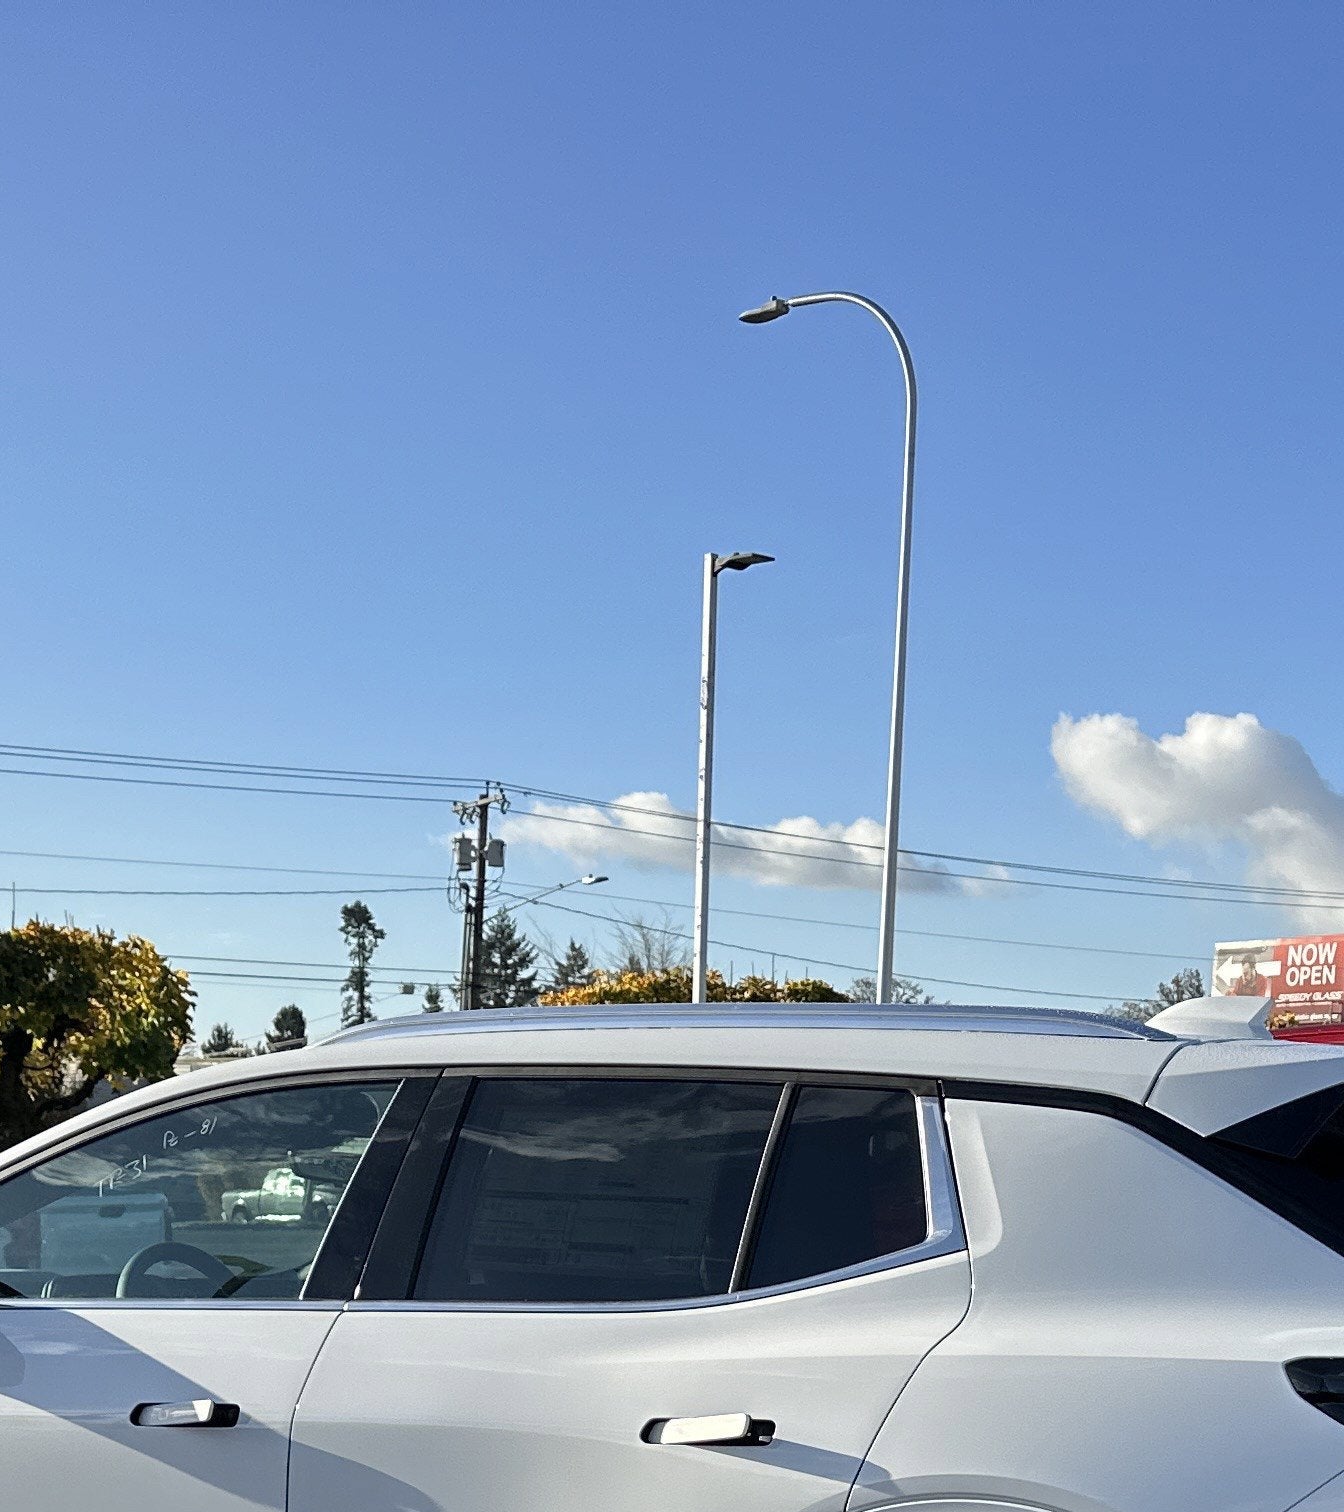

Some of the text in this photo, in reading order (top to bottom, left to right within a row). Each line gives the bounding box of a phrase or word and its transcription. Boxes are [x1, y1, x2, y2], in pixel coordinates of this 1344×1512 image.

[1286, 942, 1337, 966] NOW
[1286, 965, 1336, 987] OPEN
[1313, 991, 1344, 1001] GLASS
